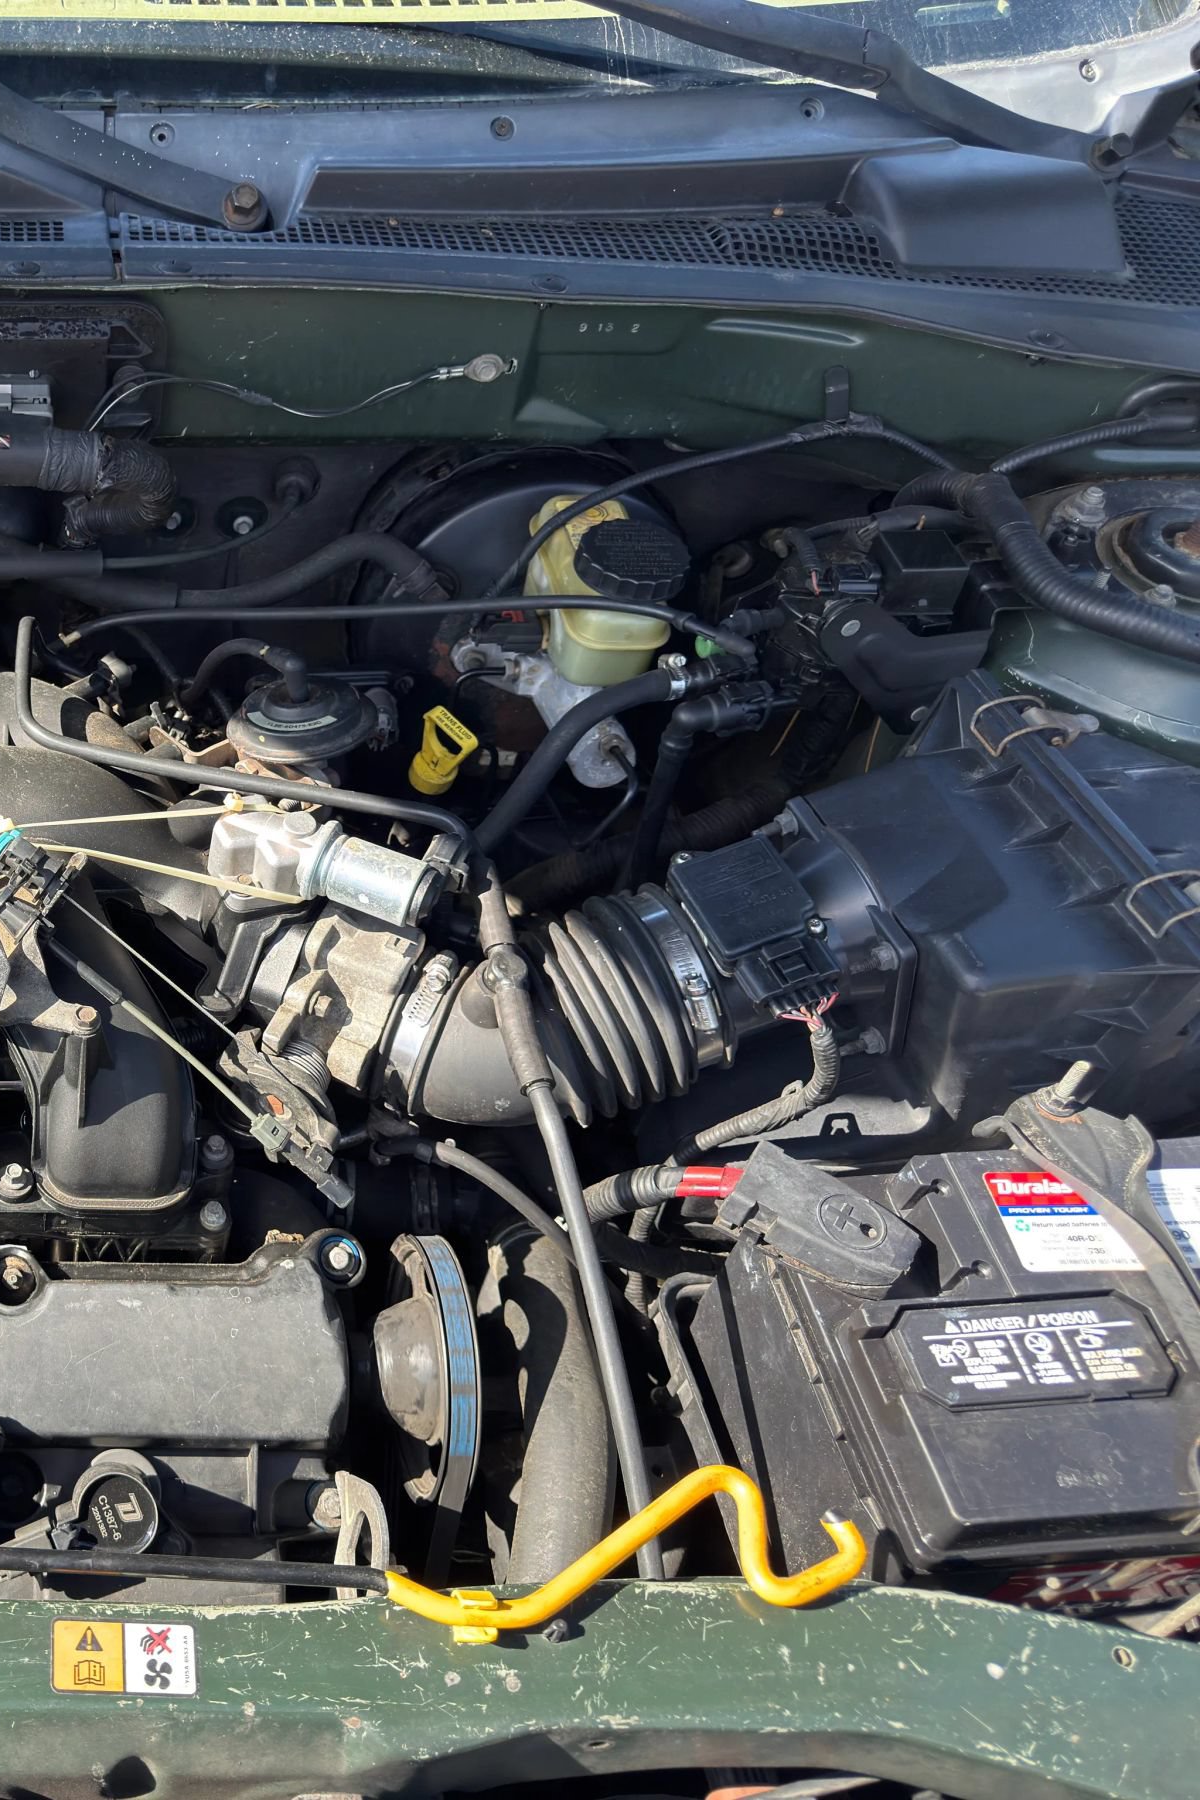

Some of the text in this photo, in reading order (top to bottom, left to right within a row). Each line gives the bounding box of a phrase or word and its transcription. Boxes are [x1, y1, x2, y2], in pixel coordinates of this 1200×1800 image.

[989, 1179, 1074, 1195] Duralas
[958, 1316, 1024, 1334] DANGER
[1036, 1310, 1101, 1330] POISON
[98, 1495, 122, 1540] C1387-6
